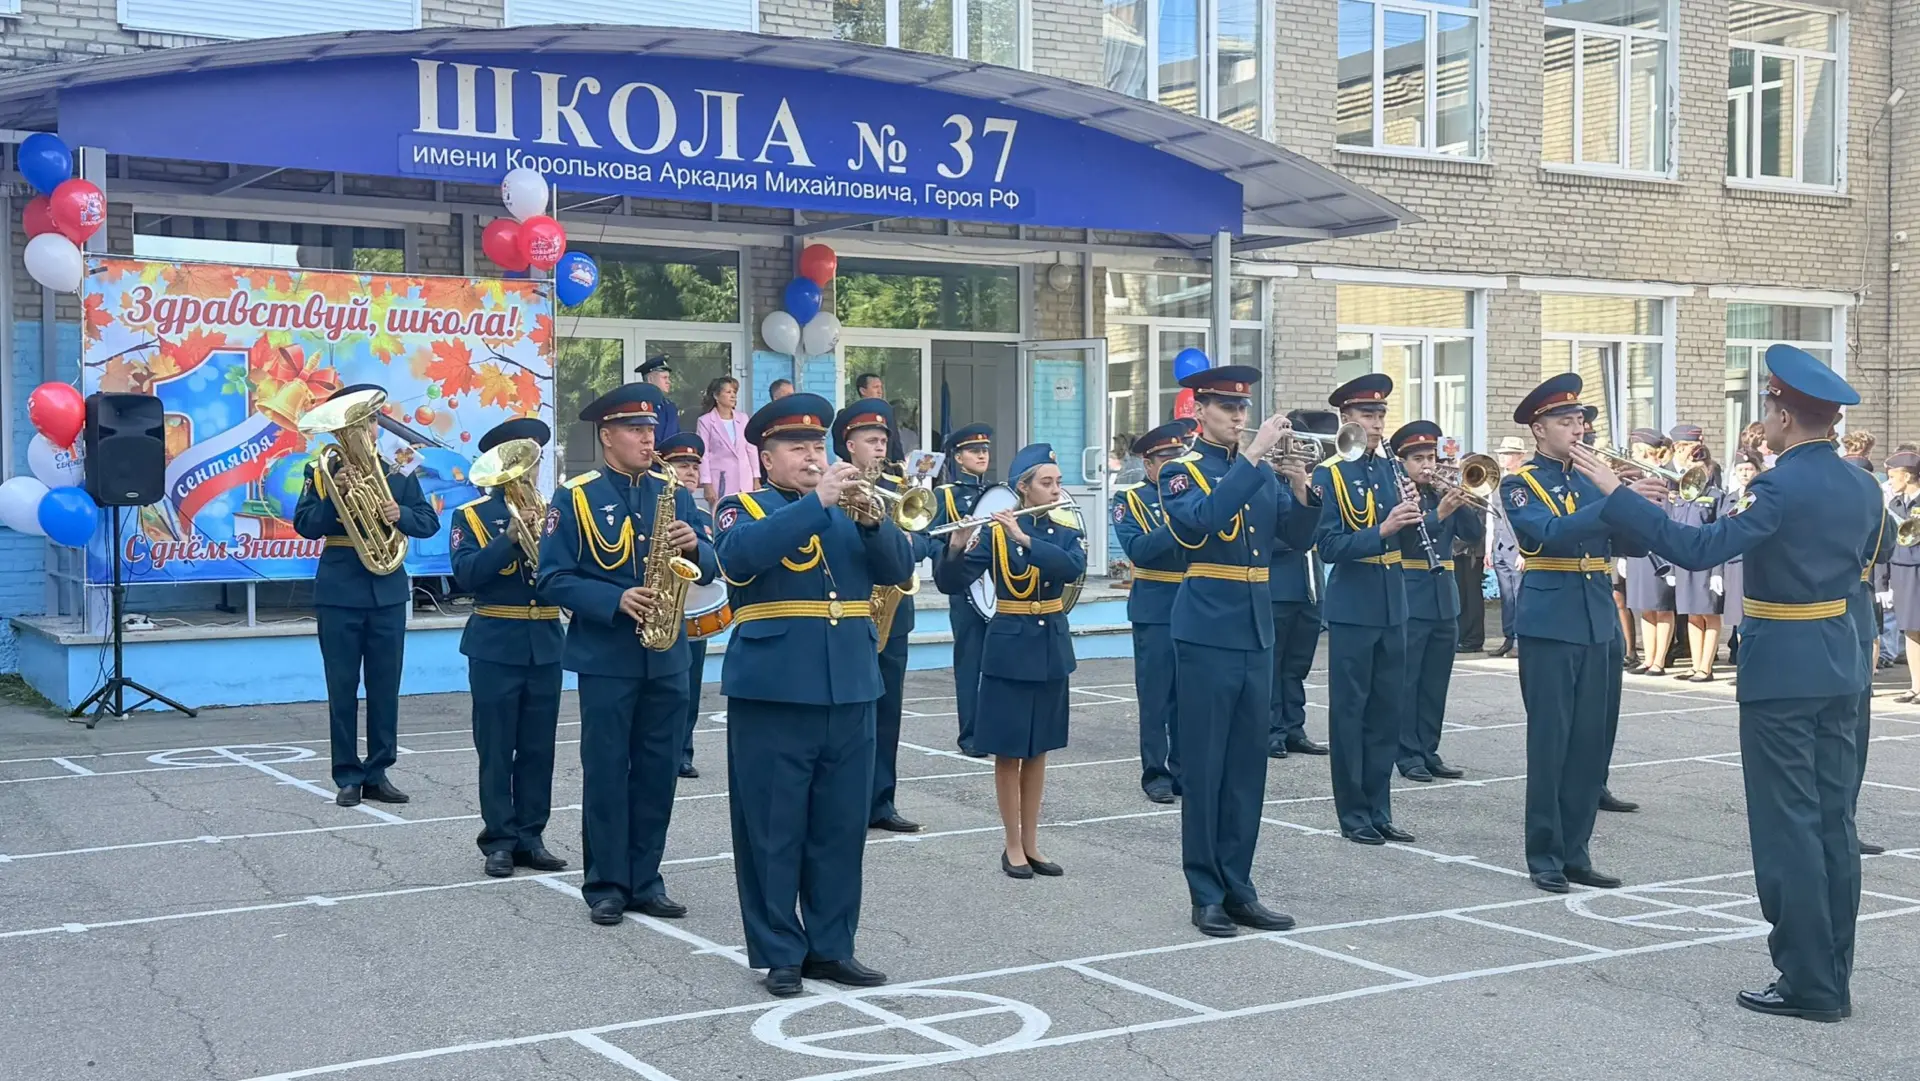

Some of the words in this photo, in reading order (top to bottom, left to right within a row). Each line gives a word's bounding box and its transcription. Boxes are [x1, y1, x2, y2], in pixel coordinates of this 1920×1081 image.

[411, 58, 816, 167] ШКОЛА
[847, 121, 907, 174] №
[936, 113, 1018, 183] 37
[412, 145, 497, 170] имени
[506, 147, 652, 182] Королькова
[659, 161, 757, 191] Аркадия
[765, 170, 918, 205] Михайловича,
[925, 183, 983, 210] Героя
[990, 188, 1020, 210] РФ
[126, 285, 377, 341] Здравствуй,
[386, 305, 519, 338] школа!
[176, 434, 274, 498] сентября
[125, 534, 145, 562] С
[151, 535, 227, 568] днём
[234, 533, 326, 559] Знани
